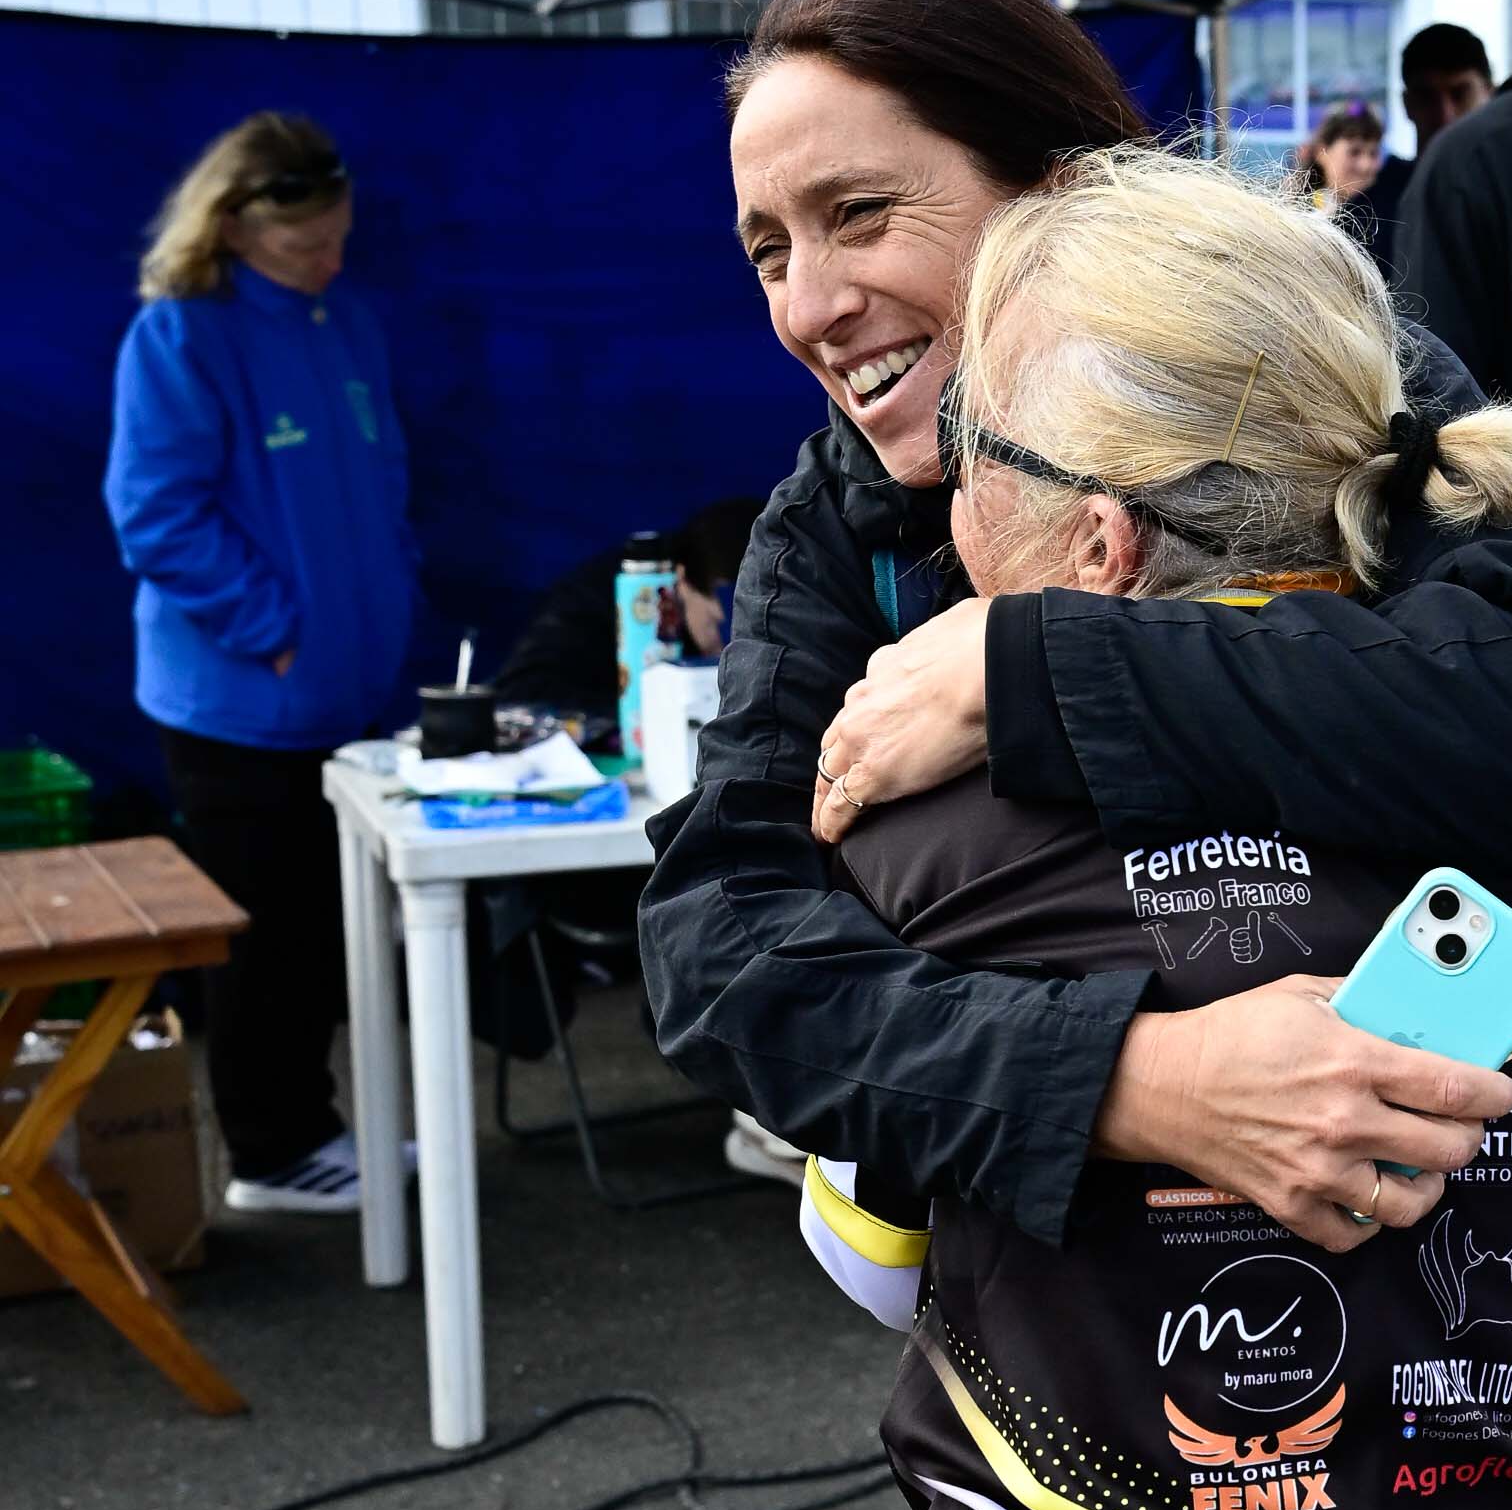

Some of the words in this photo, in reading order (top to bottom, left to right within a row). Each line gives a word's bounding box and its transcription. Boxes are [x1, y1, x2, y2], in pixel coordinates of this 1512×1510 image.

[1133, 887, 1215, 918] Remo
[1218, 878, 1312, 908] Franco
[1147, 1211, 1174, 1225] EVA
[1177, 1209, 1226, 1224] PERÓN
[1162, 1227, 1291, 1244] WWW.HIDROLONG
[1237, 1345, 1297, 1360] EVENTOS
[1224, 1371, 1241, 1391] by
[1243, 1372, 1277, 1387] maru
[1280, 1367, 1314, 1383] mora
[1422, 1427, 1479, 1442] Fogones
[1190, 1459, 1327, 1485] BULONERA
